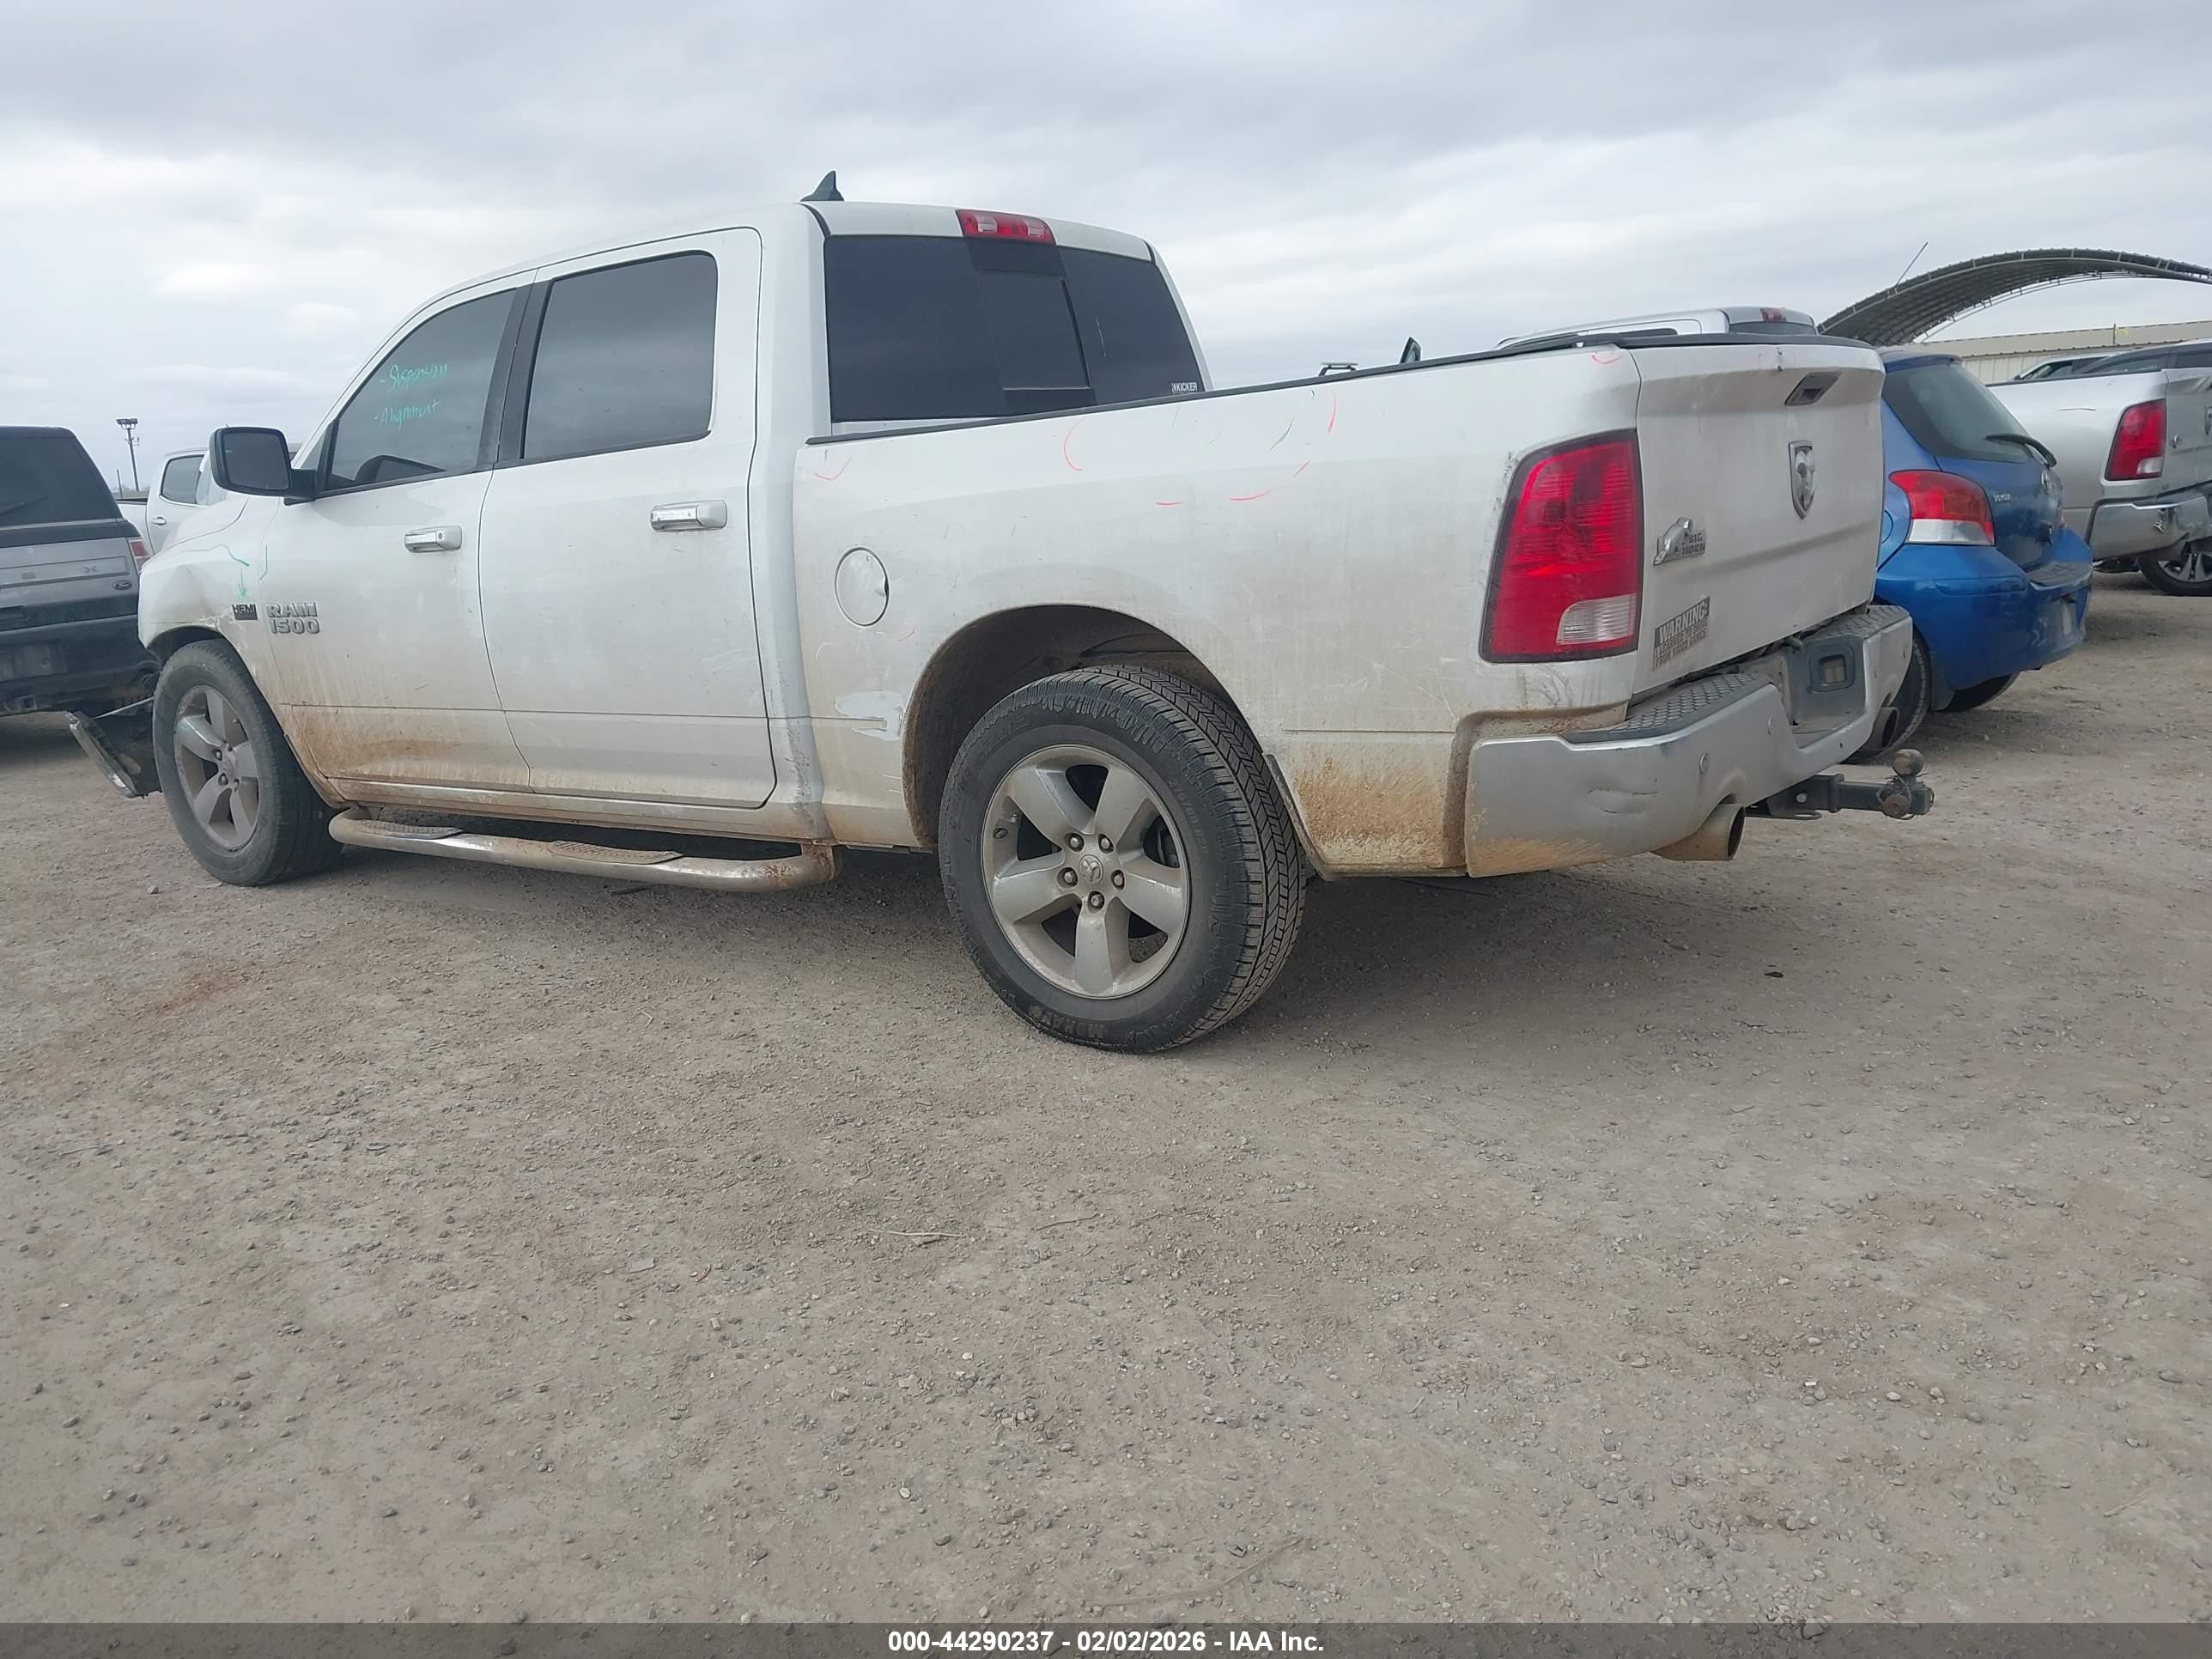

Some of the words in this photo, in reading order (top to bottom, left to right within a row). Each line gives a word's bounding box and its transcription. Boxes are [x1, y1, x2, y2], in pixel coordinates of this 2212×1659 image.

[1689, 532, 1704, 544] BIG
[265, 602, 318, 617] RAM
[269, 618, 320, 635] 1500
[1659, 600, 1709, 645] WARNING:
